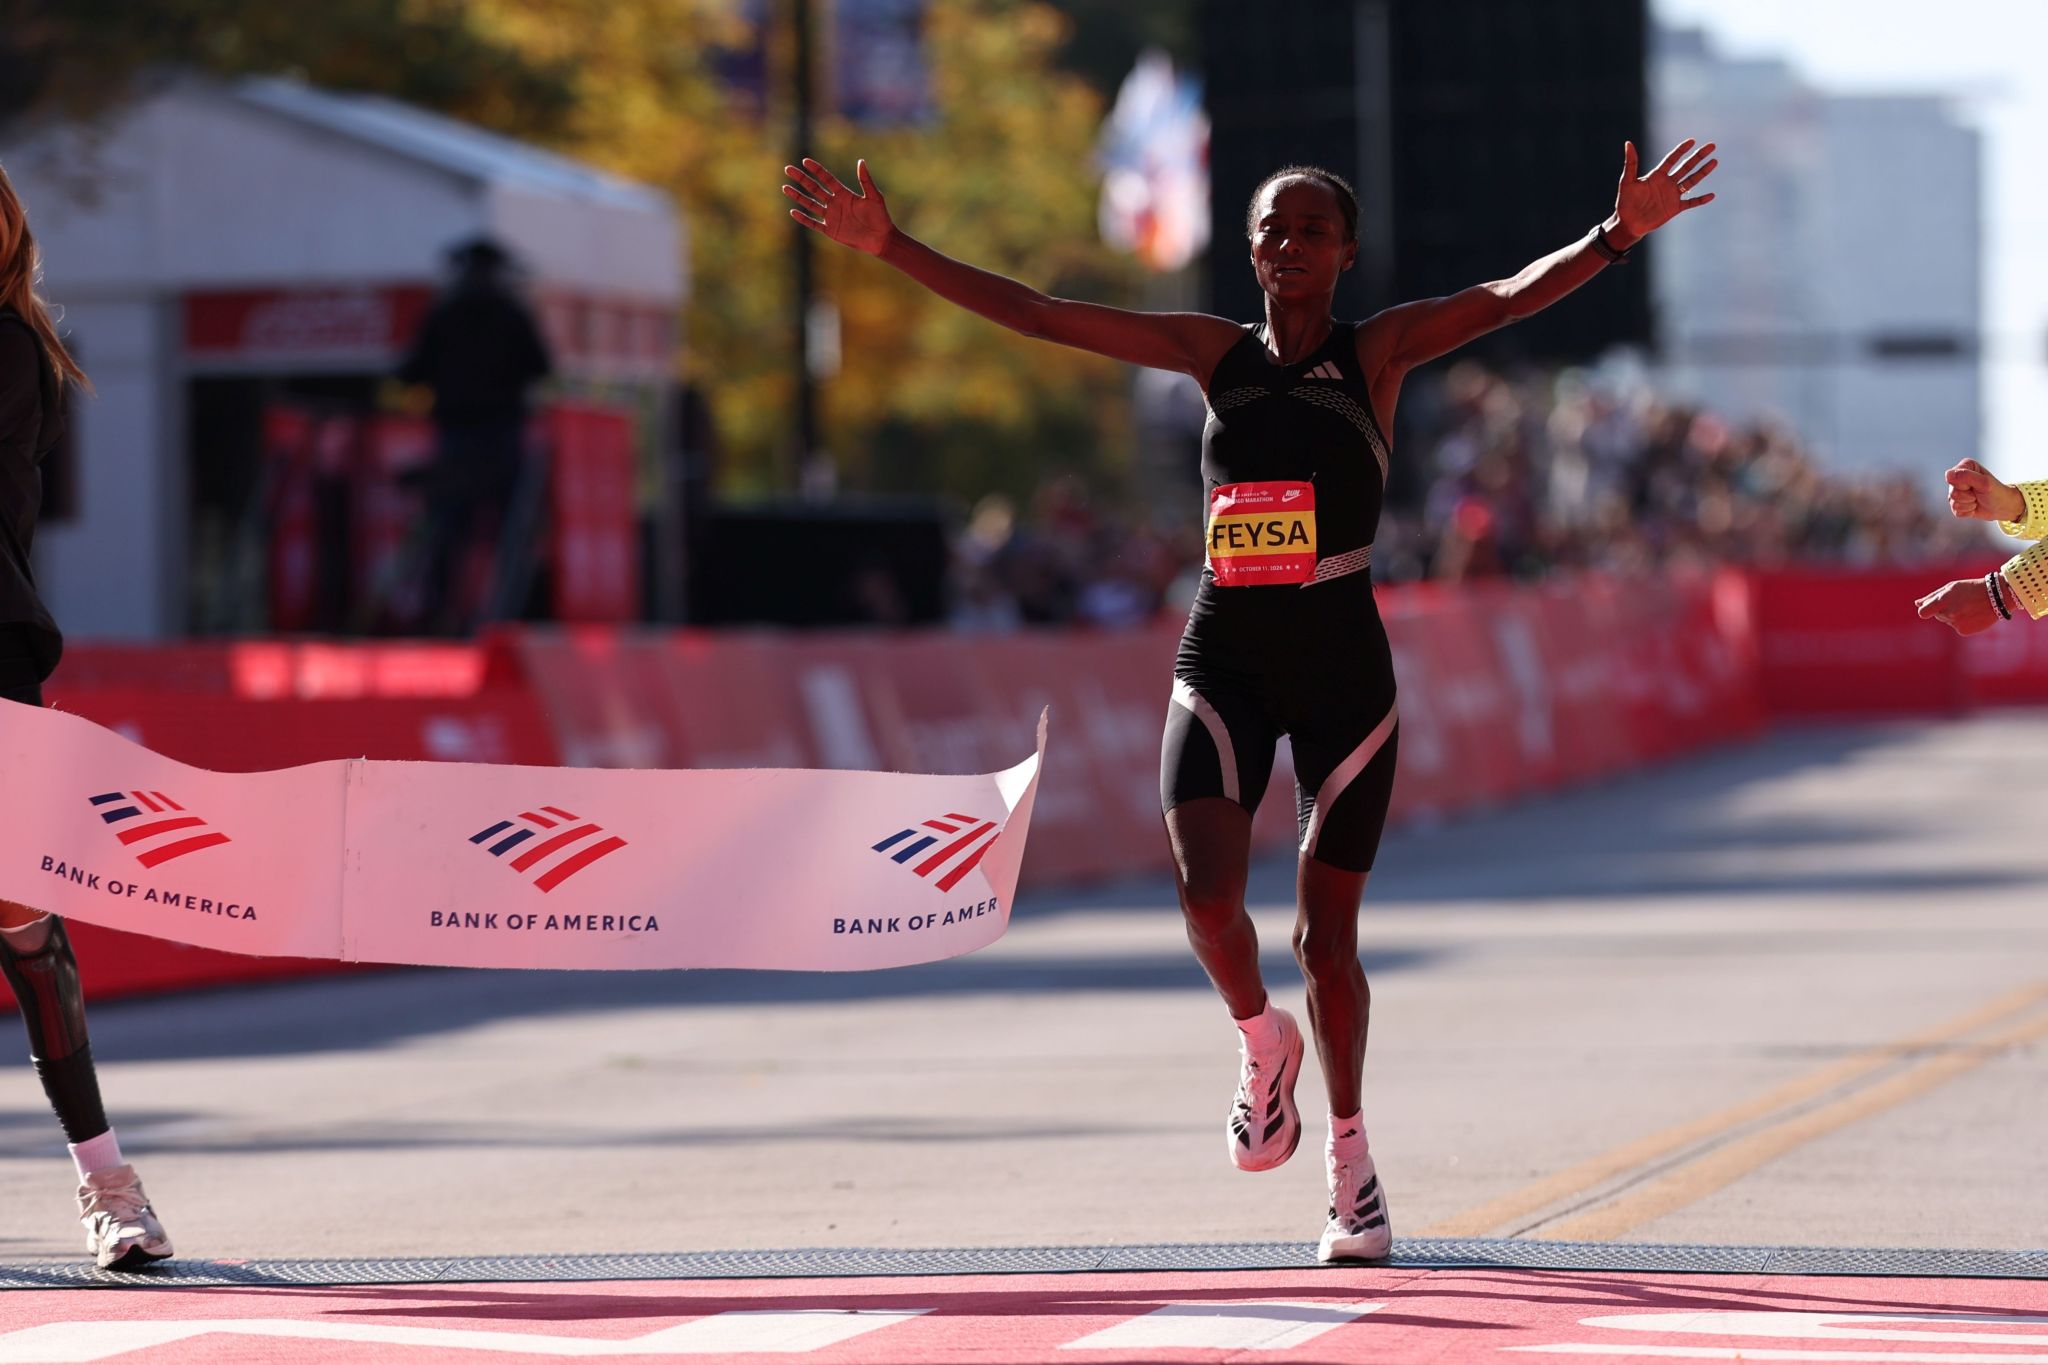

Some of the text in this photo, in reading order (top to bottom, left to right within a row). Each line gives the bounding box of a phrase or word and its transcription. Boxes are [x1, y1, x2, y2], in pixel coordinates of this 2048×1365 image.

[1212, 520, 1309, 549] FEYSA
[40, 855, 257, 920] BANK OF AMERICA
[430, 911, 659, 931] BANK OF AMERICA
[833, 897, 997, 934] BANK OF AMER
